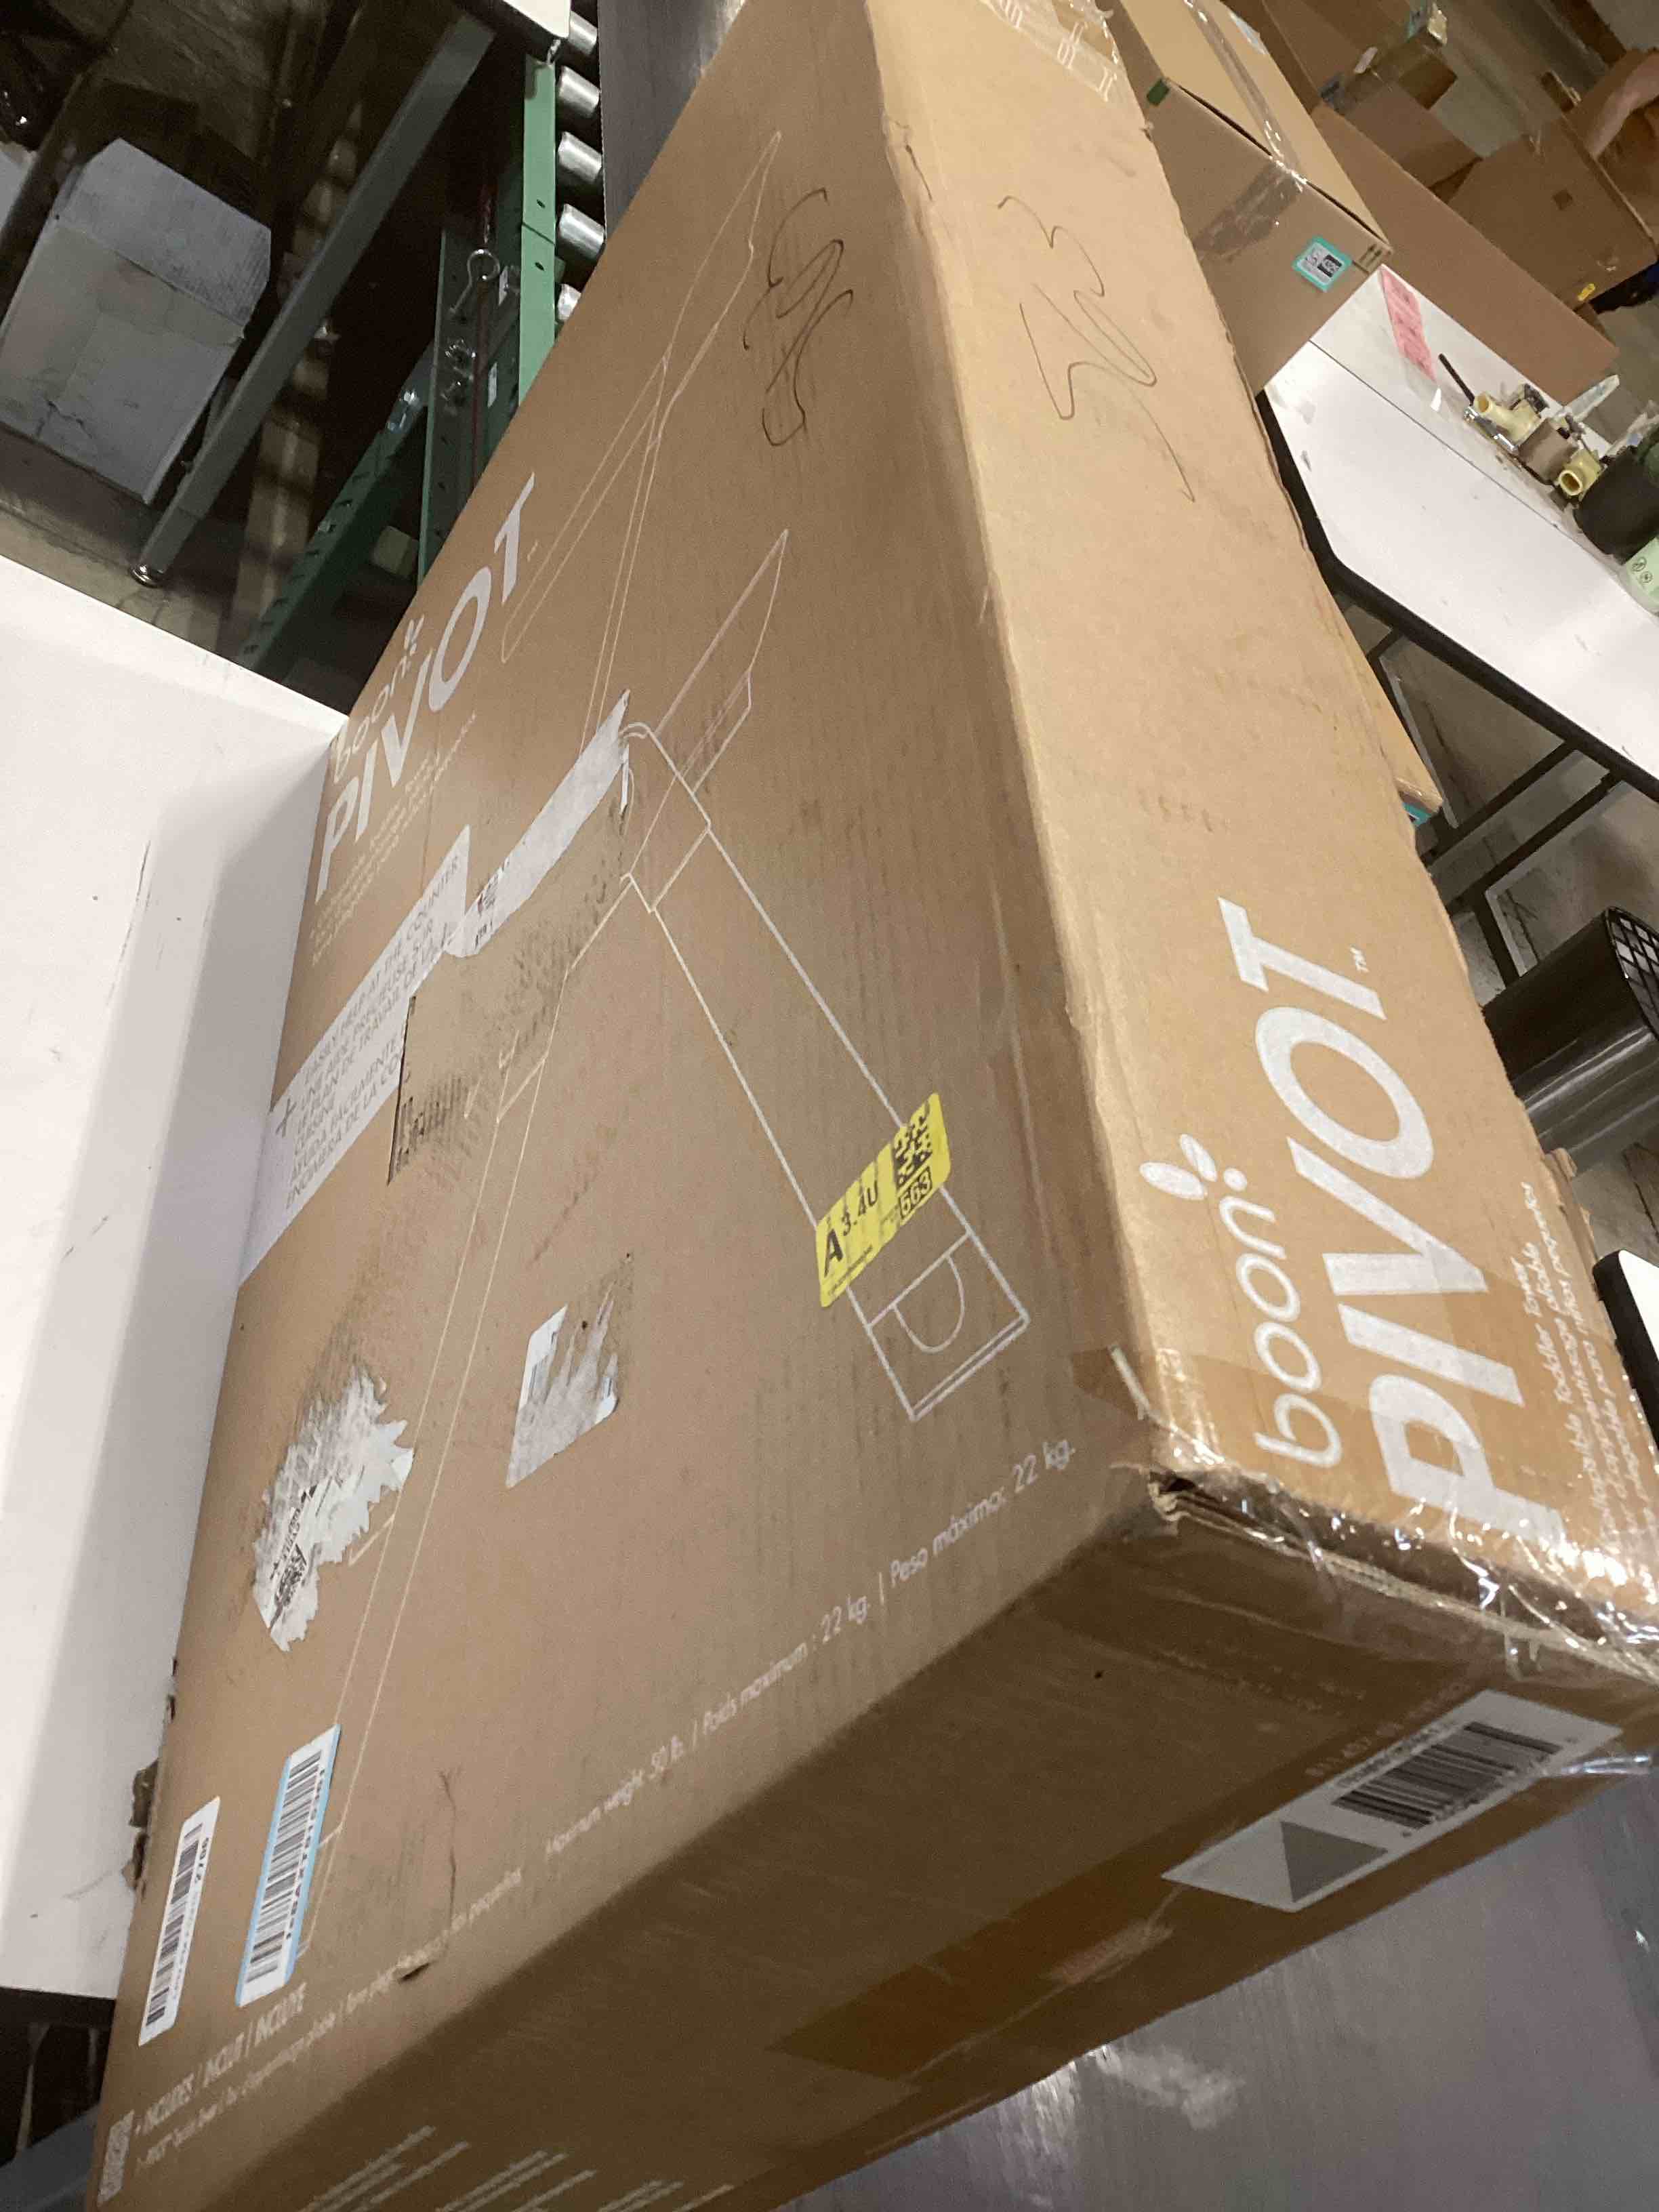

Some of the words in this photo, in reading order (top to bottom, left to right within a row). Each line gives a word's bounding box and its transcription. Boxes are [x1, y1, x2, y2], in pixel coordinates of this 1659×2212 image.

[315, 472, 535, 905] PIVOT
[383, 935, 402, 977] THE
[405, 852, 458, 943] COUNTER
[411, 913, 433, 960] SUR
[824, 1228, 843, 1277] A
[1218, 896, 1571, 1560] PIVOT
[1511, 1256, 1542, 1317] Tower
[1522, 1242, 1572, 1316] pliable
[1219, 1195, 1343, 1468] boon
[1534, 1323, 1573, 1404] Toddler
[1582, 1340, 1616, 1396] para
[821, 1606, 842, 1644] 22
[890, 1547, 928, 1588] Peso
[1014, 1454, 1038, 1493] 22
